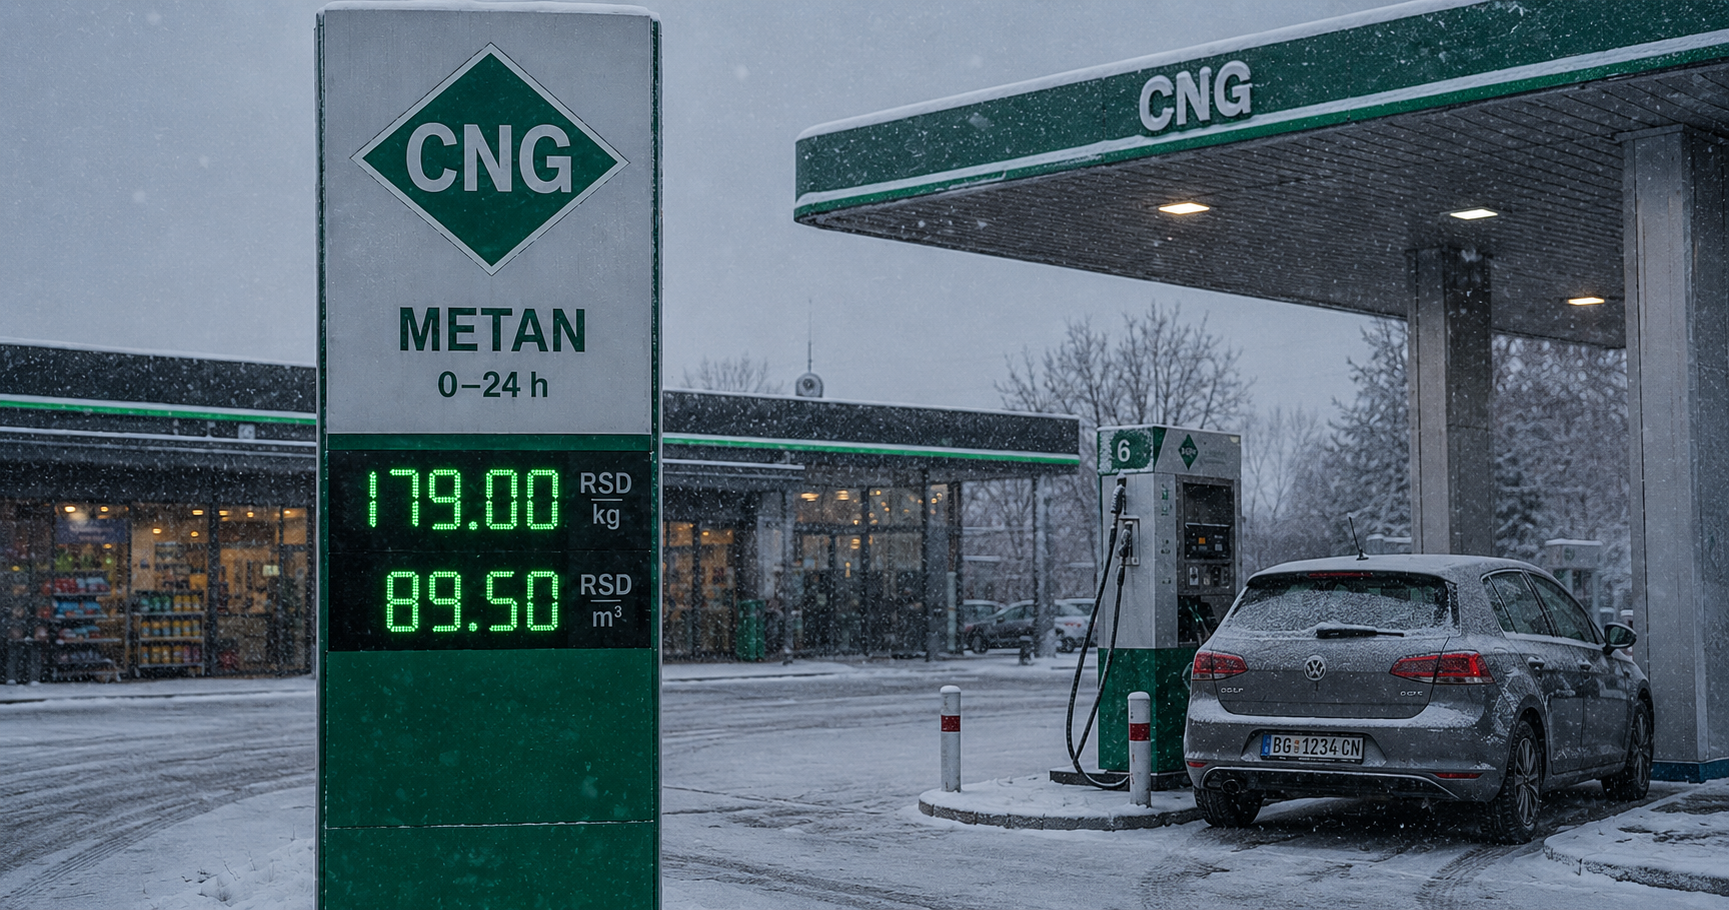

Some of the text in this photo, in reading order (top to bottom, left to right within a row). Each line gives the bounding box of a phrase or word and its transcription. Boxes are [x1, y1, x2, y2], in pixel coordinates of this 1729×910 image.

[1139, 60, 1252, 131] CNG
[405, 122, 572, 193] CNG
[400, 307, 586, 352] METAN
[530, 371, 549, 398] h
[1117, 439, 1131, 462] 6
[579, 472, 632, 494] RSD
[369, 468, 558, 530] 179.00
[592, 503, 620, 530] kg
[579, 574, 632, 595] RSD
[386, 571, 558, 632] 89.50
[1273, 737, 1360, 756] BG 1234 CN
